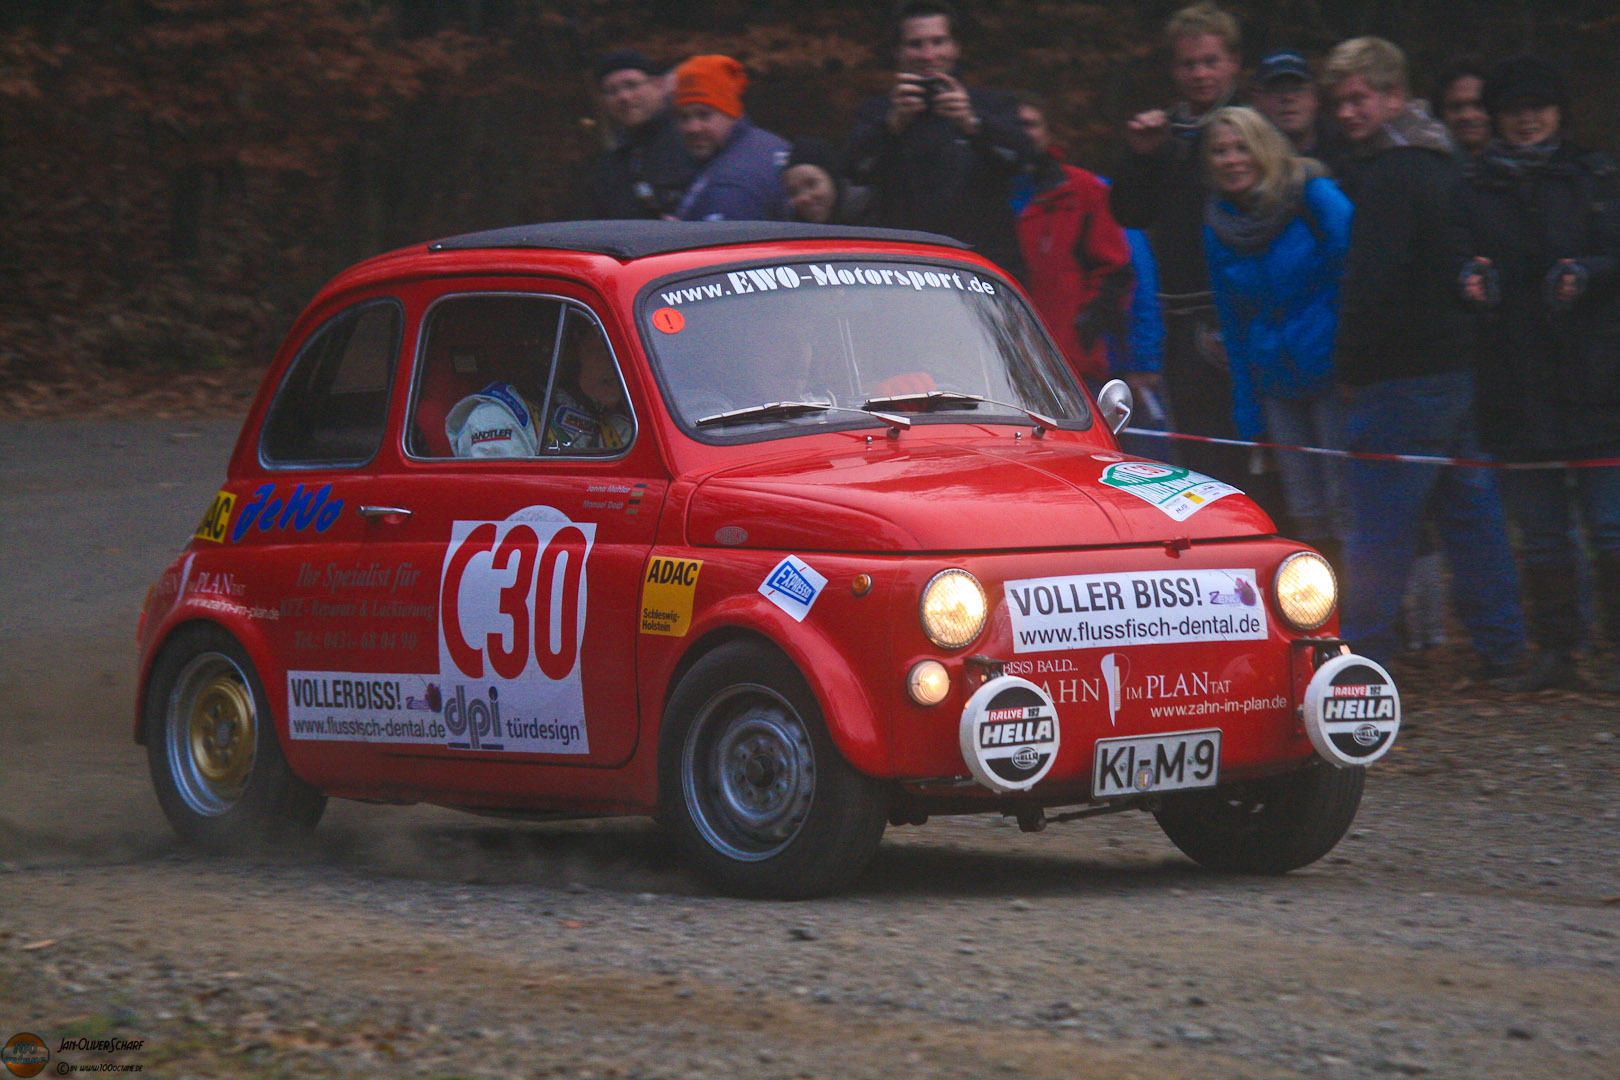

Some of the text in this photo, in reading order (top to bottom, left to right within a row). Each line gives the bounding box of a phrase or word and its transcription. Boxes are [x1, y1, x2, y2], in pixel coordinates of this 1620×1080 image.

[661, 264, 996, 306] www.EWO-Motorsport.de
[389, 562, 421, 594] für
[647, 559, 698, 586] ADAC
[773, 565, 814, 600] EXPRESSO
[441, 523, 587, 680] C30
[1011, 577, 1203, 616] VOLLER BISS!
[642, 620, 671, 632] Holstein
[643, 607, 680, 623] Schleswig-
[1019, 614, 1261, 646] www.flussfisch-dental.de
[1002, 661, 1033, 675] BIS(S)
[1040, 678, 1101, 704] AHN
[1126, 686, 1142, 700] IM
[1335, 686, 1366, 697] RALLYE
[444, 685, 502, 749] dpi
[989, 708, 1024, 721] RALLYE
[1150, 694, 1287, 719] www.zahn-im-plan.de
[1325, 698, 1393, 720] HELLA
[506, 718, 580, 745] türdesign
[982, 719, 1052, 745] HELLA
